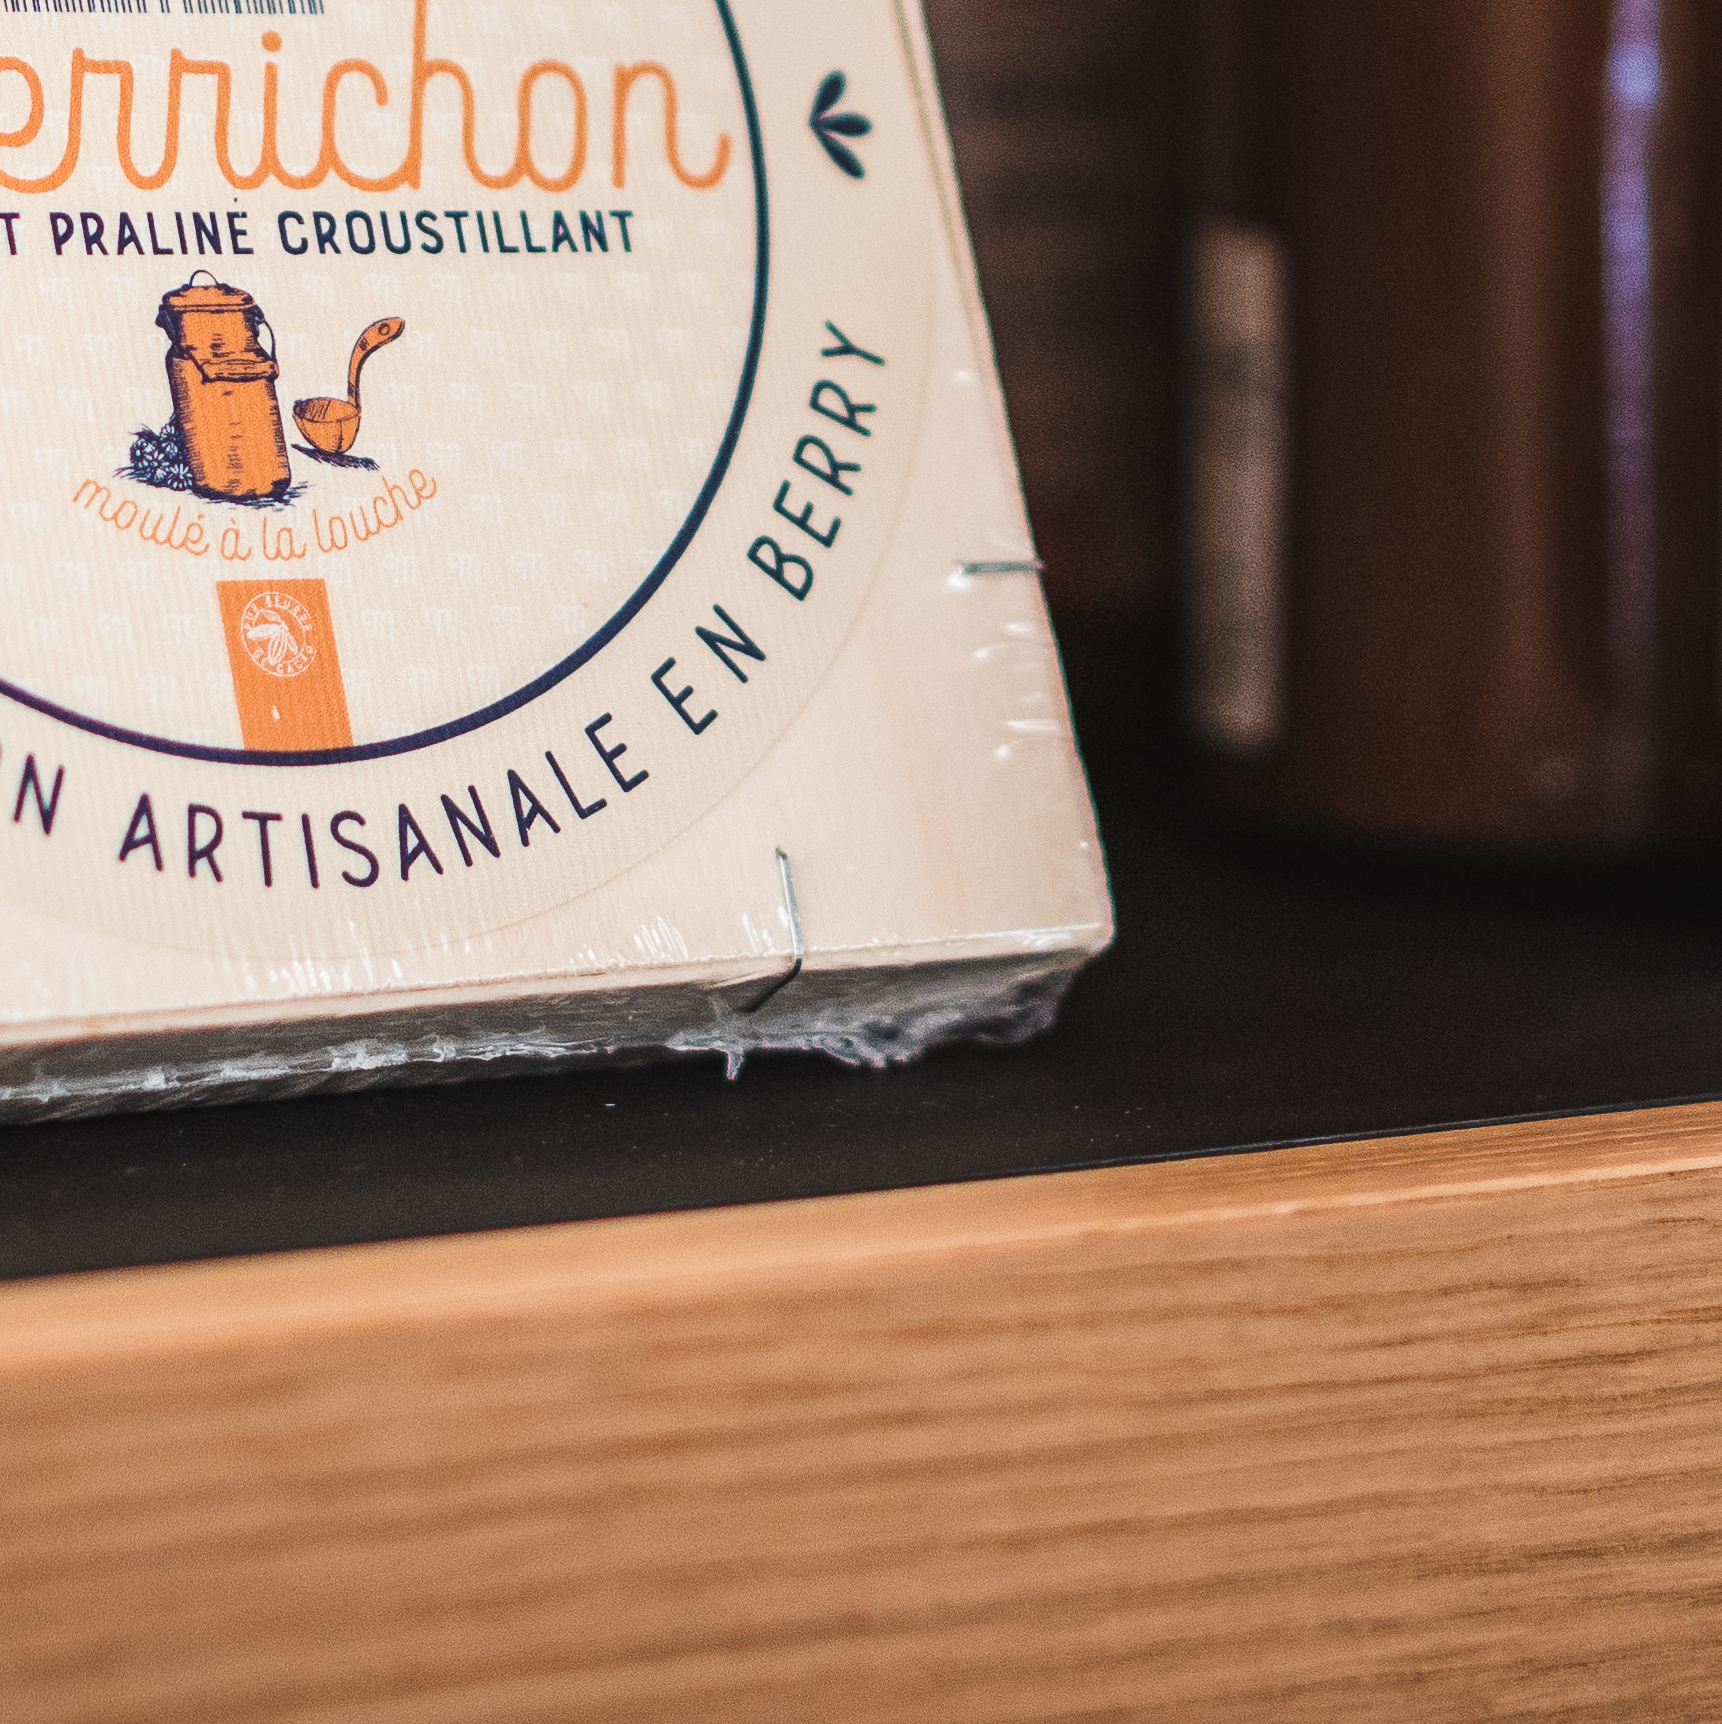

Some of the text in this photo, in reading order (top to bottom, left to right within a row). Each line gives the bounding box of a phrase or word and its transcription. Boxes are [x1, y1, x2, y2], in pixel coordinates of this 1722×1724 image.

[276, 209, 635, 256] CROUSTILLANT
[71, 466, 440, 563] moulé à la louche
[118, 711, 652, 890] ARTISANALE
[649, 603, 769, 737] EN
[745, 319, 888, 603] BERRY
